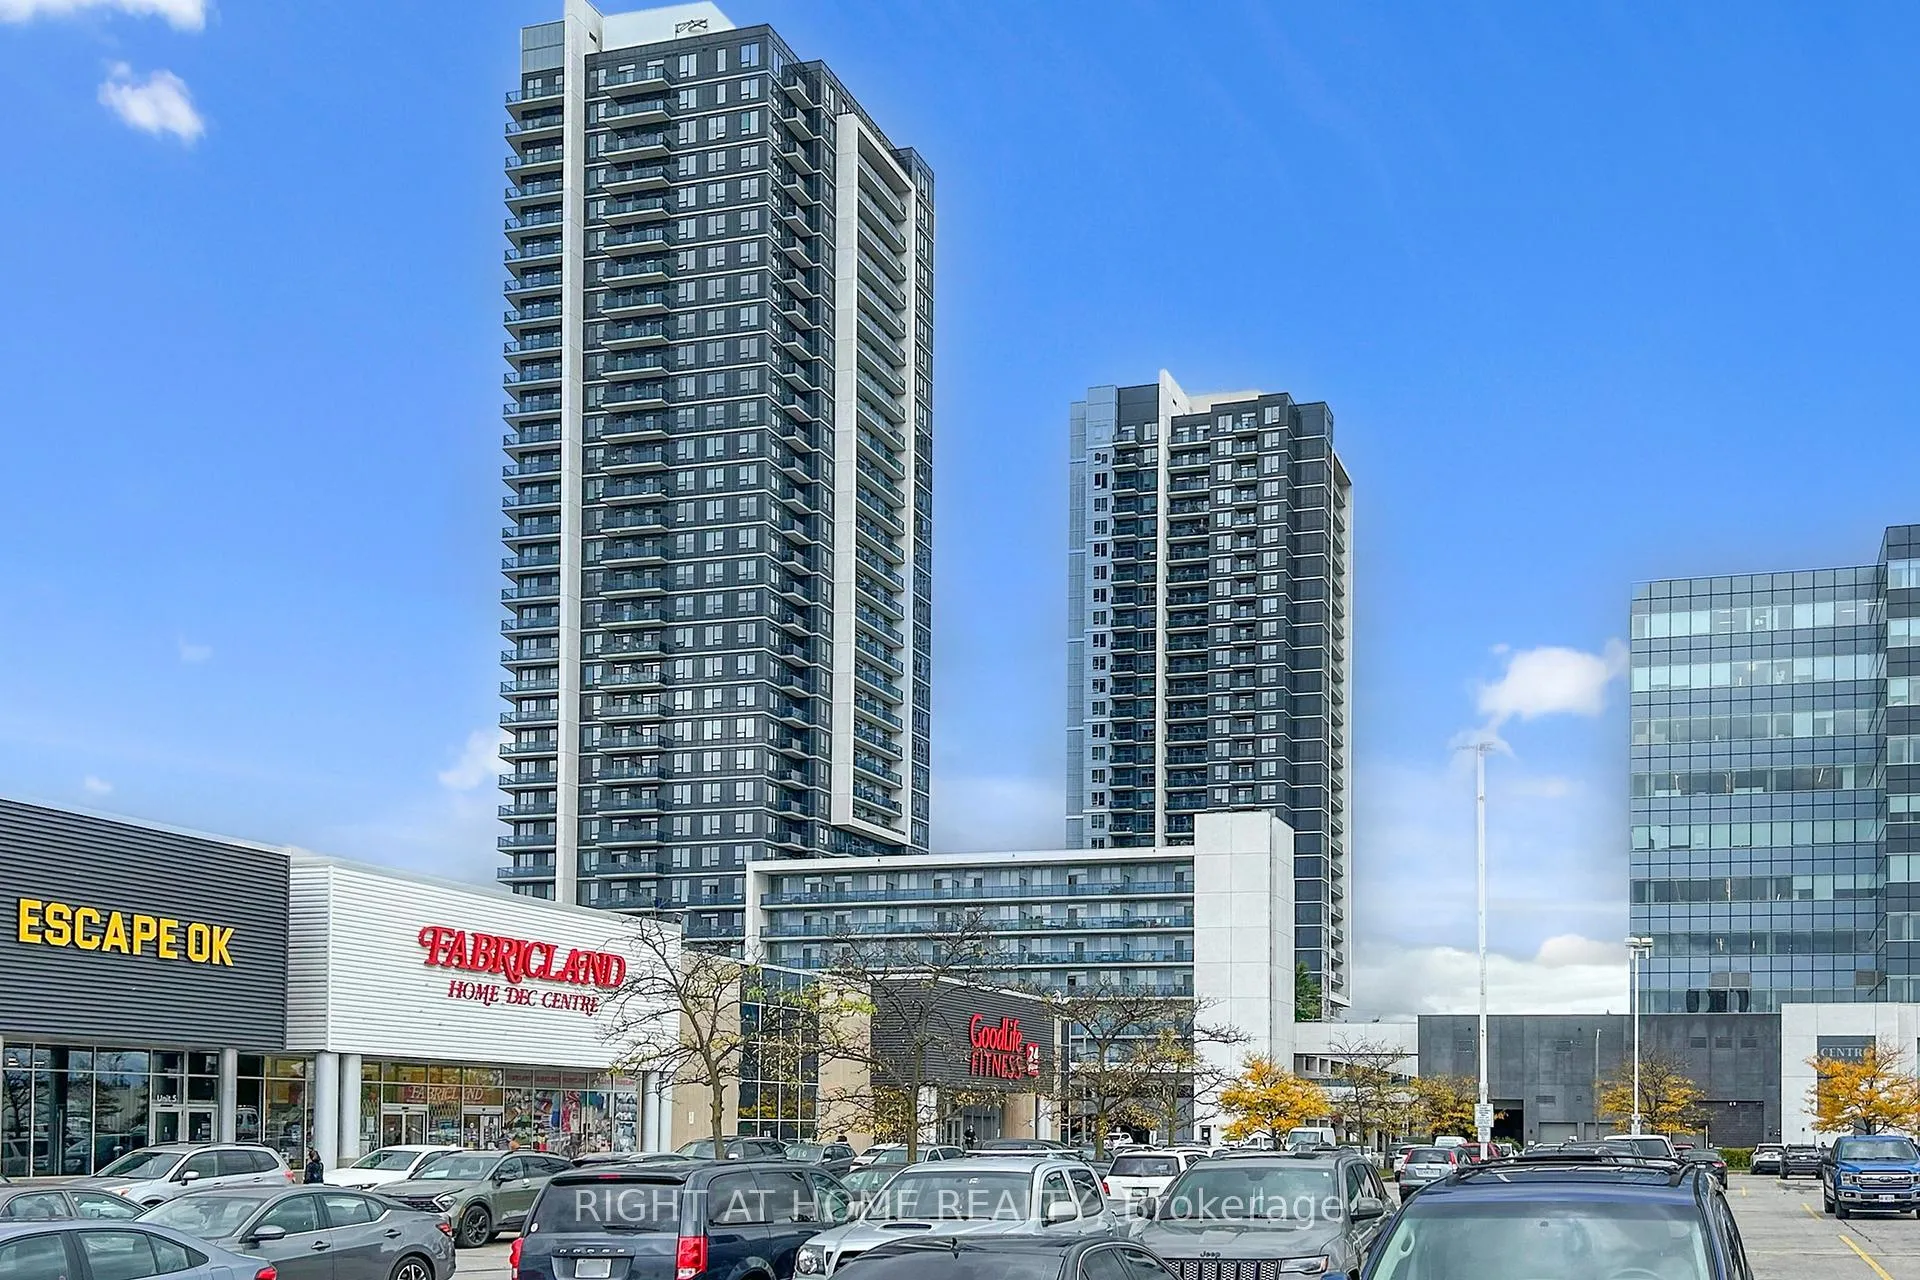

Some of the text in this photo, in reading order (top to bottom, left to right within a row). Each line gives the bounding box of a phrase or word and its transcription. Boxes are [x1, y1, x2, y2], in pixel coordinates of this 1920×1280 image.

[18, 898, 235, 967] ESCAPE OK
[418, 926, 627, 988] FABRICLAND
[448, 980, 600, 1017] HOME DEC CENTRE
[970, 1013, 1023, 1053] GoodLife
[971, 1052, 1023, 1079] FITNESS
[1199, 1250, 1221, 1259] Jeep
